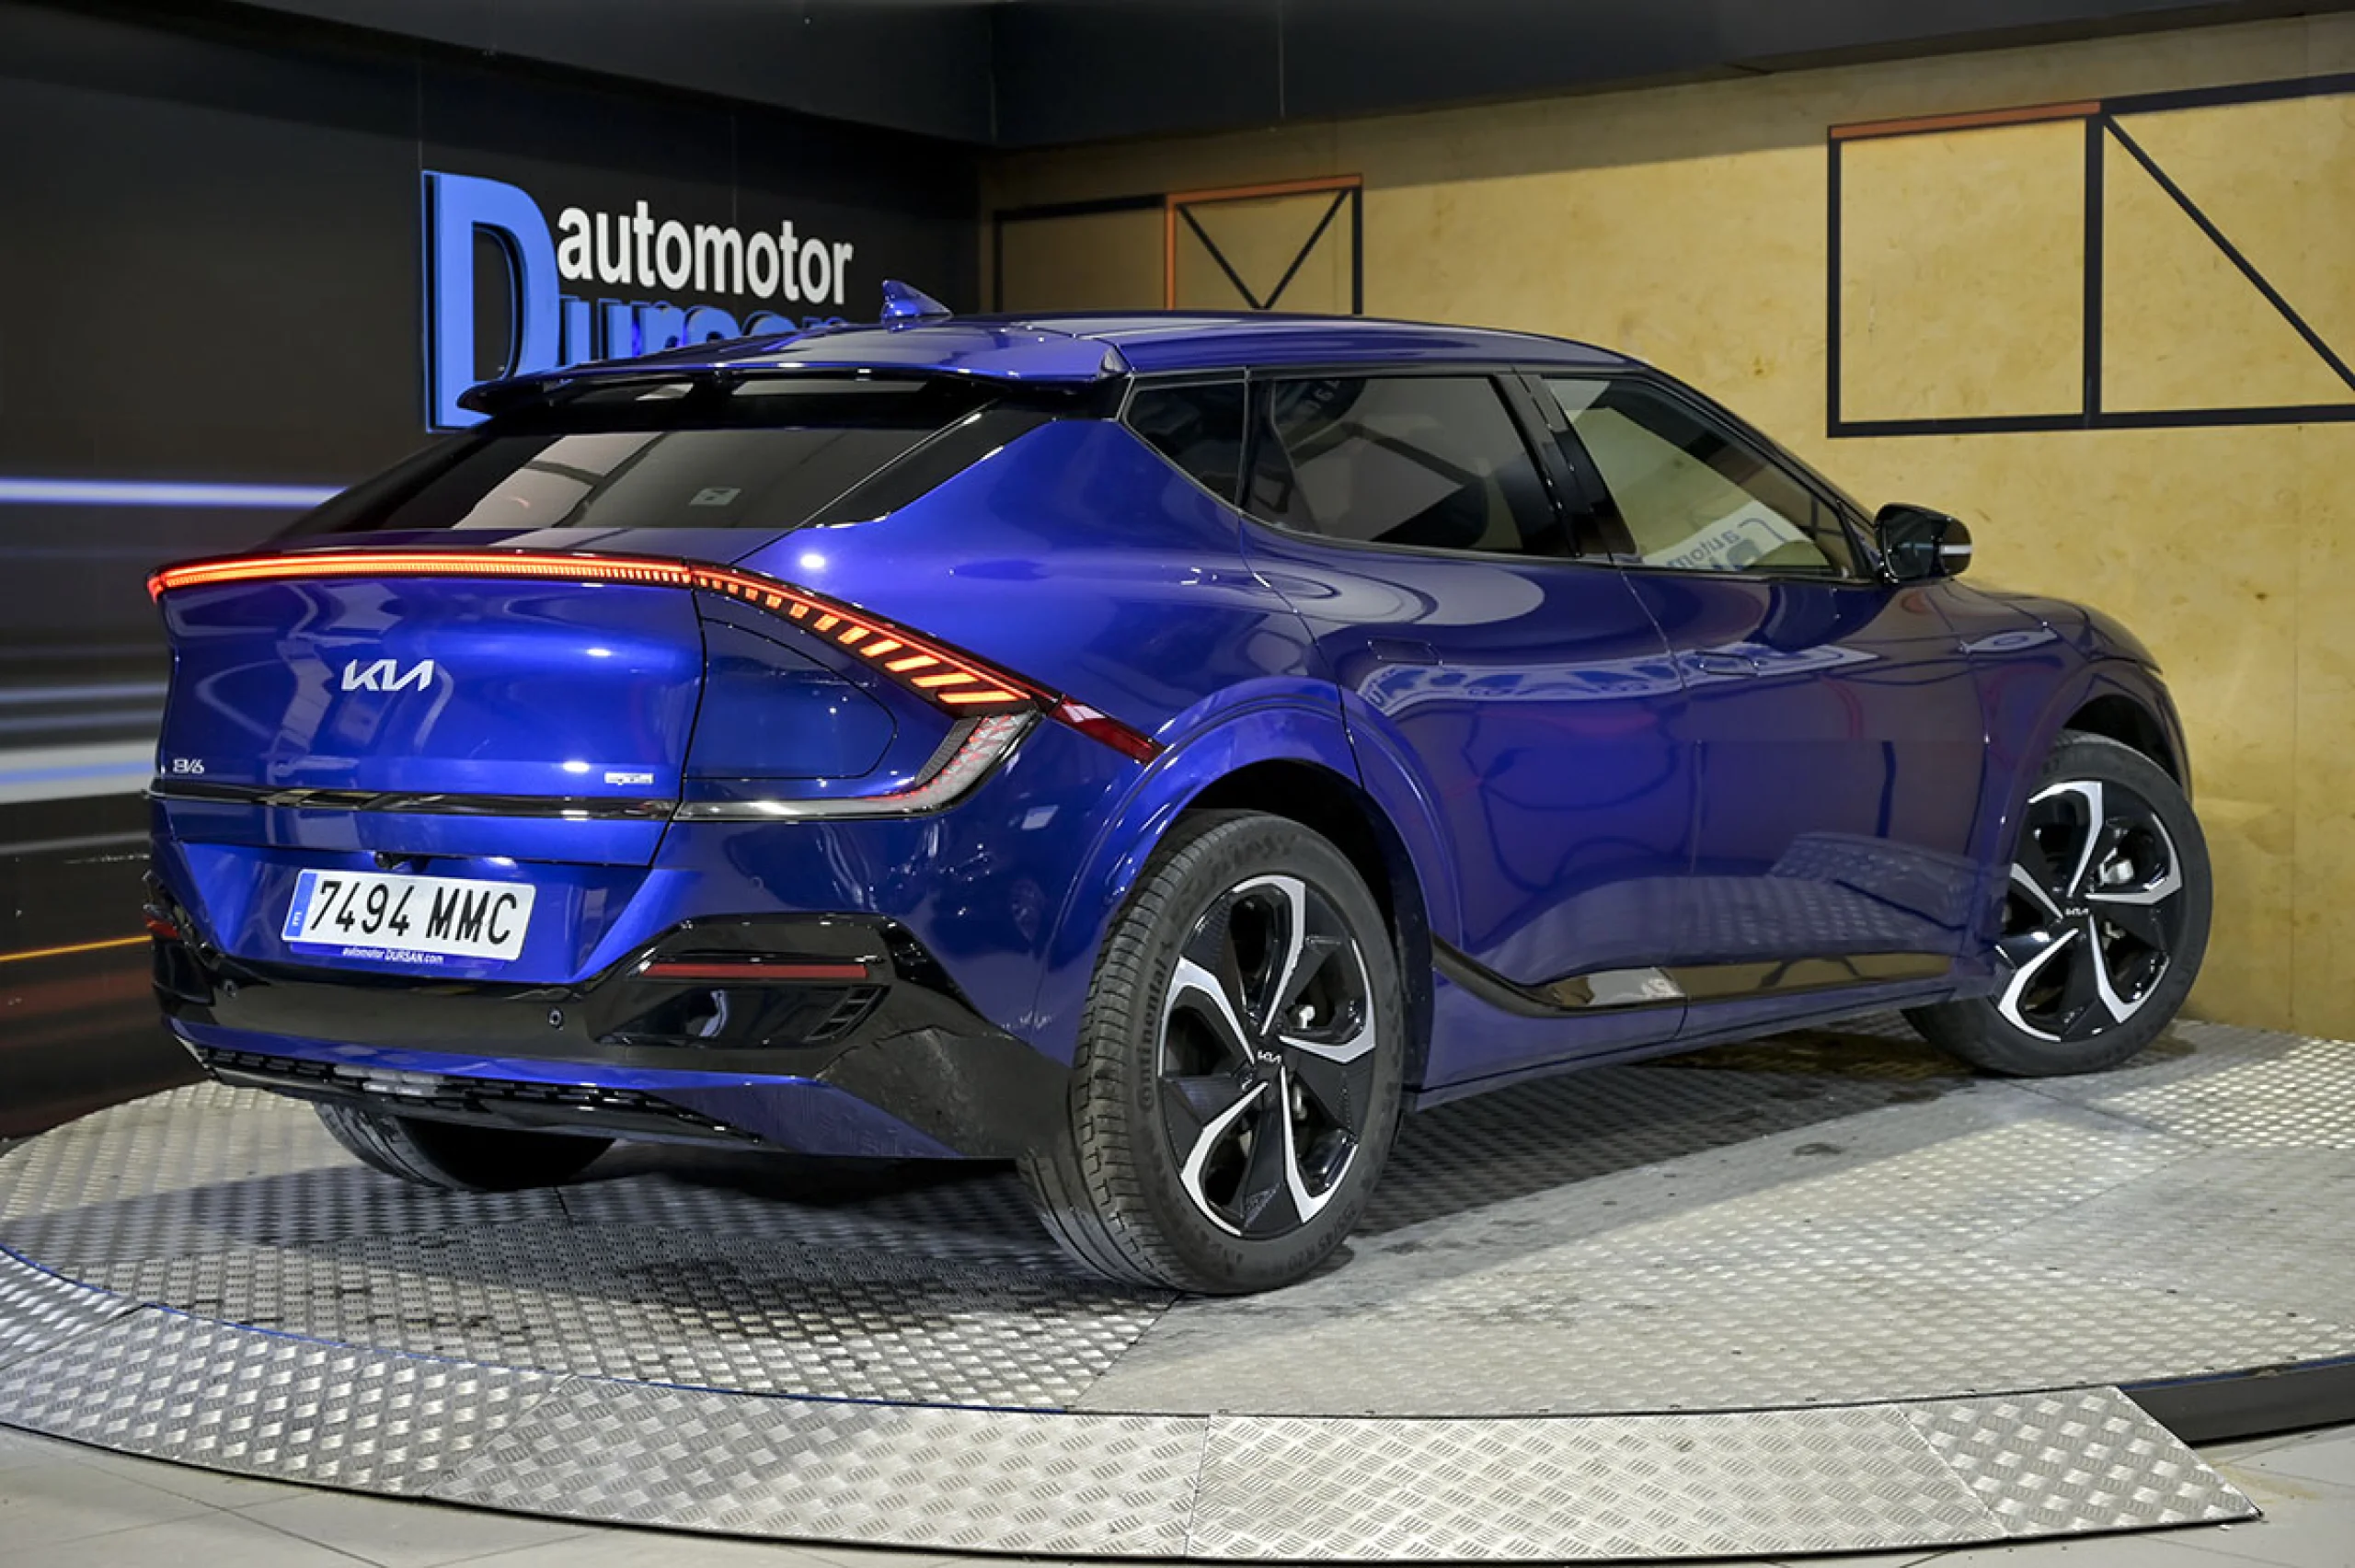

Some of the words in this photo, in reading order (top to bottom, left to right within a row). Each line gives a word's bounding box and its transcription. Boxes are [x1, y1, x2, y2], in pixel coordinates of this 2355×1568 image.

[557, 200, 854, 305] automotor
[341, 658, 434, 692] KIA
[310, 880, 415, 937] 7494
[426, 886, 517, 945] MMC
